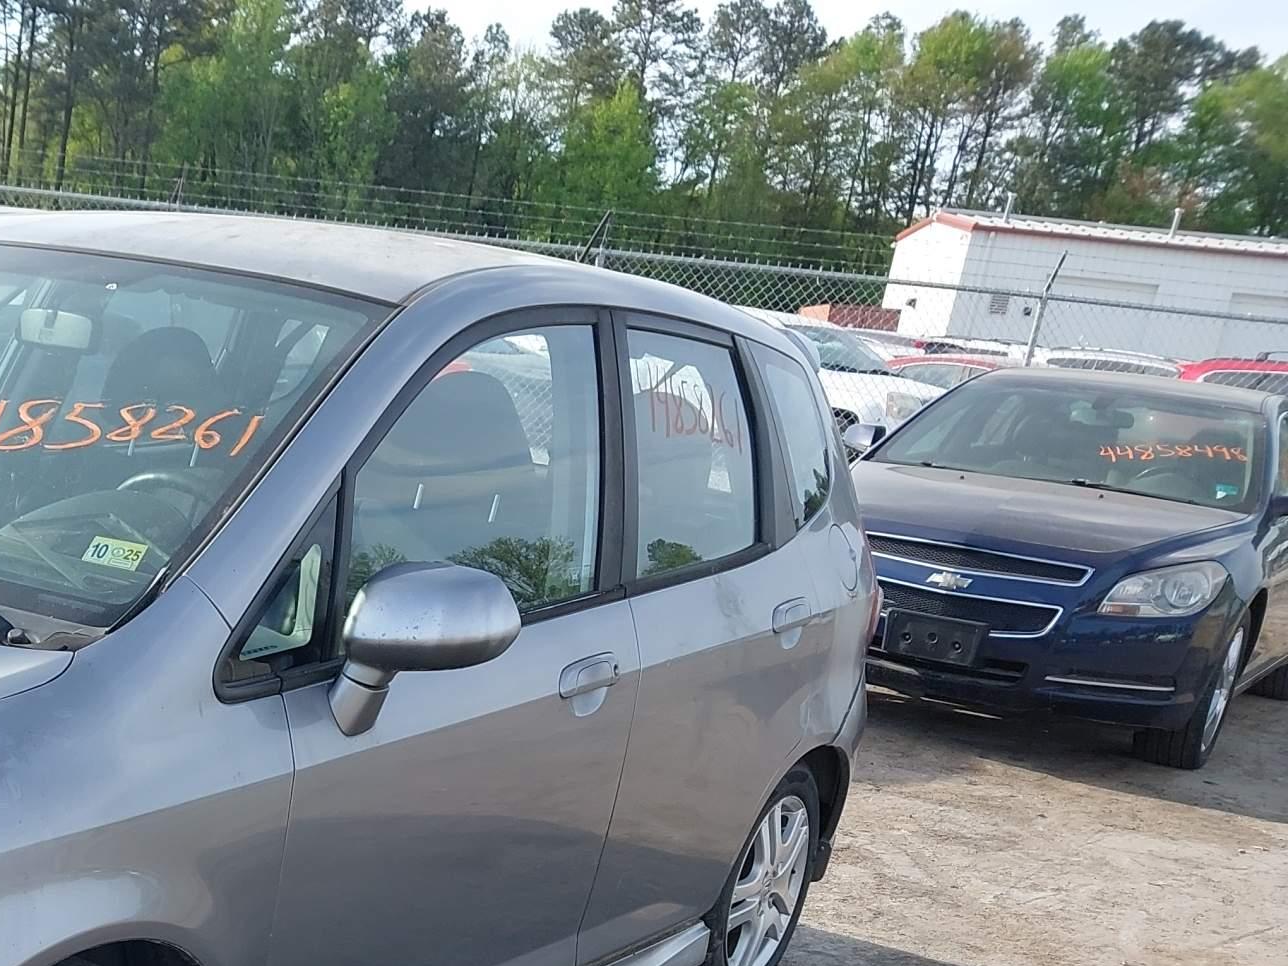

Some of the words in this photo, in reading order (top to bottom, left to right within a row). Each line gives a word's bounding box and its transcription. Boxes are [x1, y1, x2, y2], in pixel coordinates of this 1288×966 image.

[1099, 444, 1248, 463] 44858498
[89, 542, 110, 559] 10
[122, 549, 143, 562] 25
